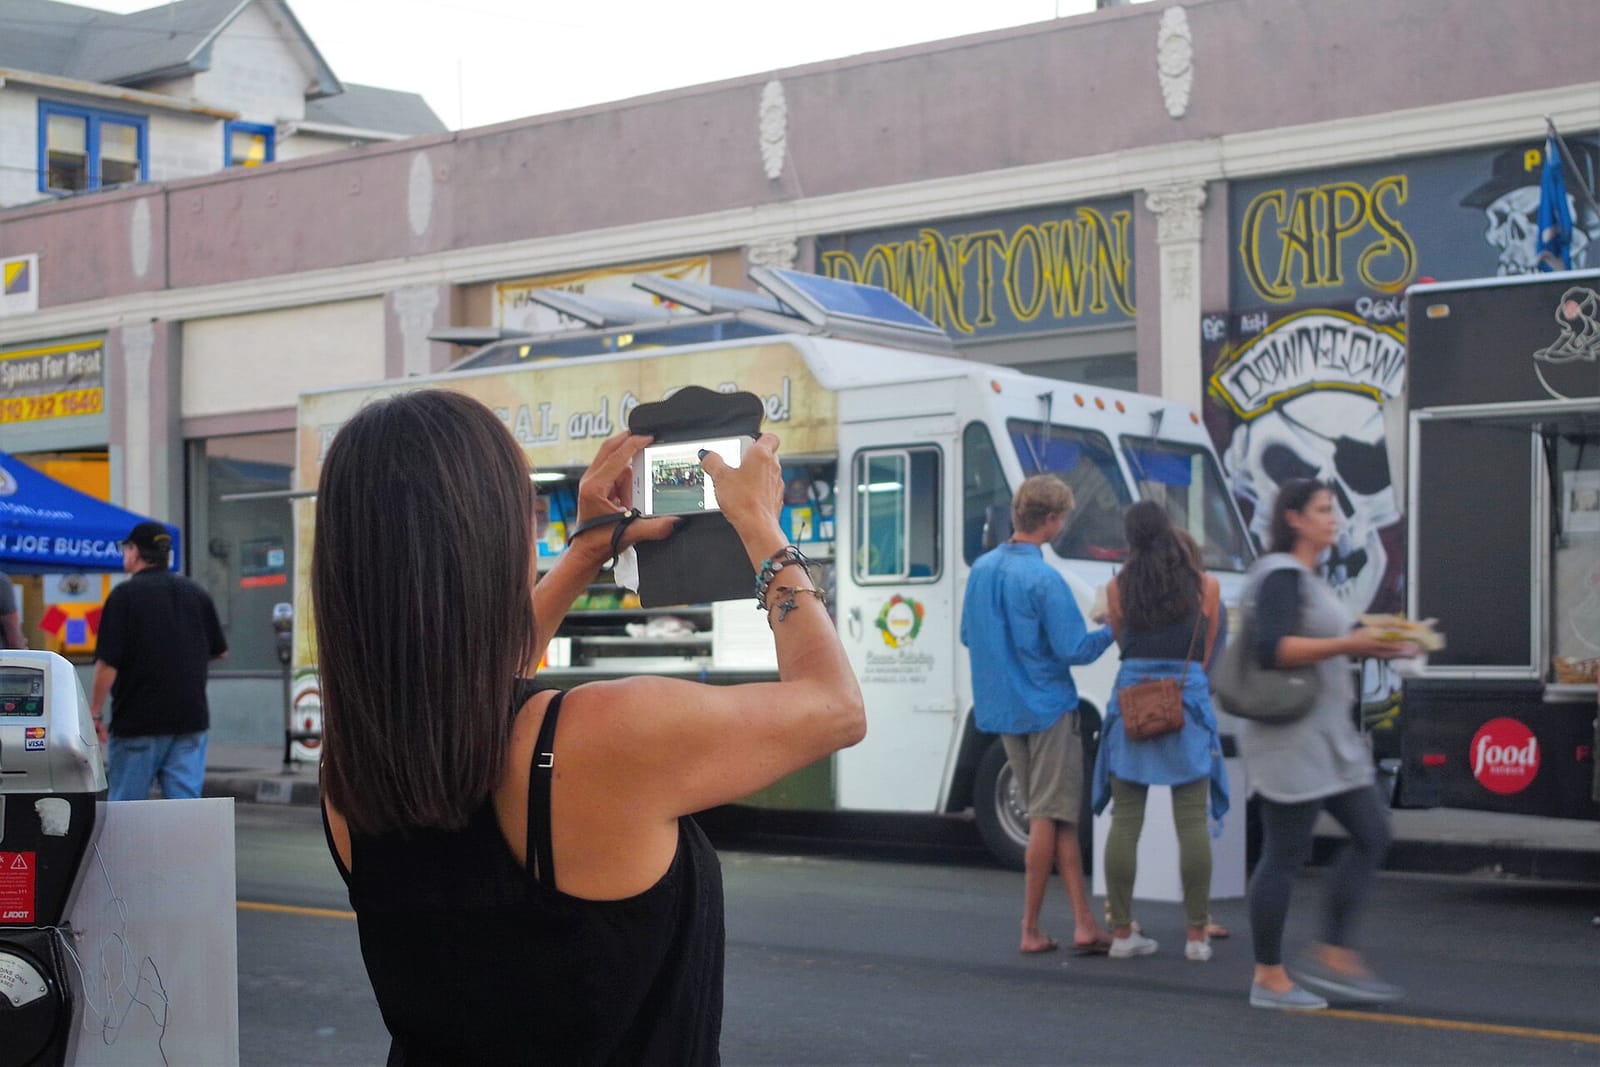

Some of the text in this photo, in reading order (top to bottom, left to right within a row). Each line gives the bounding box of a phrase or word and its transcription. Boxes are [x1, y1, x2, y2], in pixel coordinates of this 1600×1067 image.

[1240, 175, 1417, 303] CAPS
[0, 360, 40, 390] Space
[42, 355, 65, 380] For
[568, 396, 612, 440] and
[11, 535, 50, 553] JOE
[54, 538, 124, 559] BUSCA
[1474, 735, 1537, 778] food
[3, 911, 29, 919] LADOT
